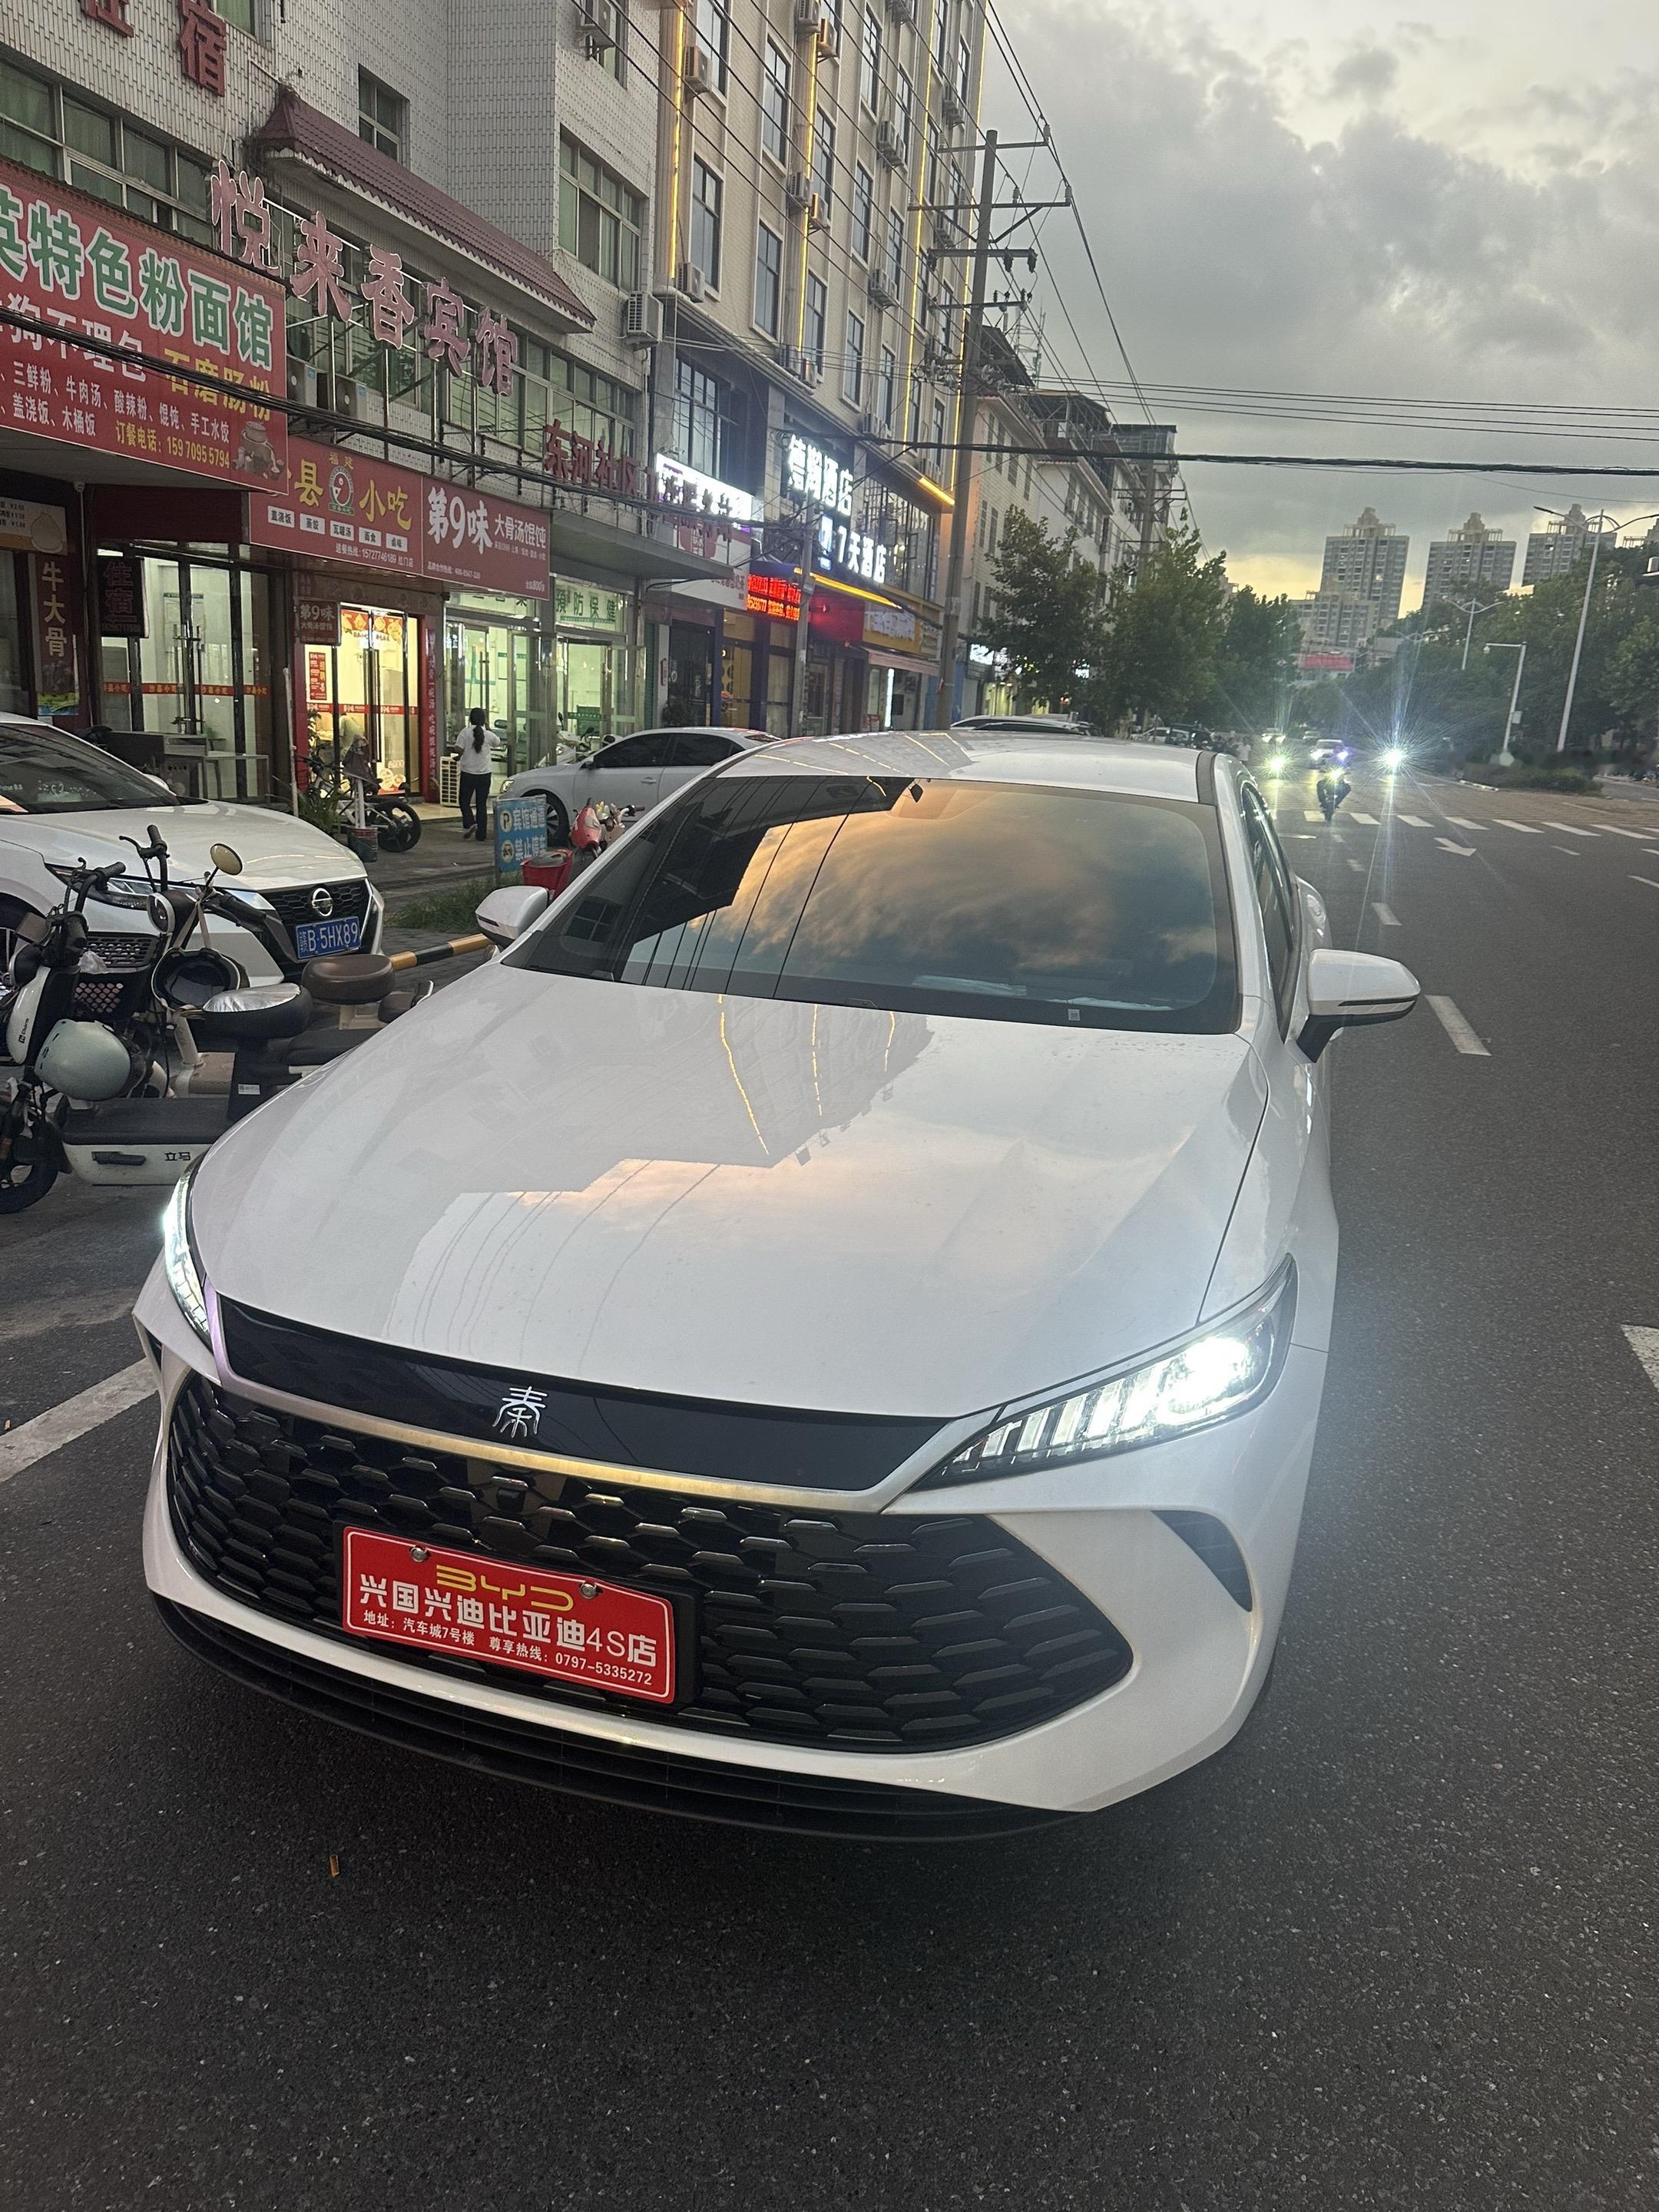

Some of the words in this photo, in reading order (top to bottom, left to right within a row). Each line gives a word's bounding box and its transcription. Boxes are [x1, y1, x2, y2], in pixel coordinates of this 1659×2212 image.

[210, 159, 518, 397] 悦来香宾馆
[0, 293, 146, 382] 狗不理包
[271, 510, 291, 524] 盖浇饭
[427, 486, 492, 555] 第9味
[495, 514, 546, 548] 大骨汤馄饨
[837, 525, 886, 584] 7天酒店
[41, 561, 68, 657] 牛大骨
[300, 604, 336, 621] 第9味
[492, 1386, 548, 1439] 秦
[436, 1565, 574, 1611] BYD
[359, 1573, 657, 1667] 兴国兴迪比亚迪4S店
